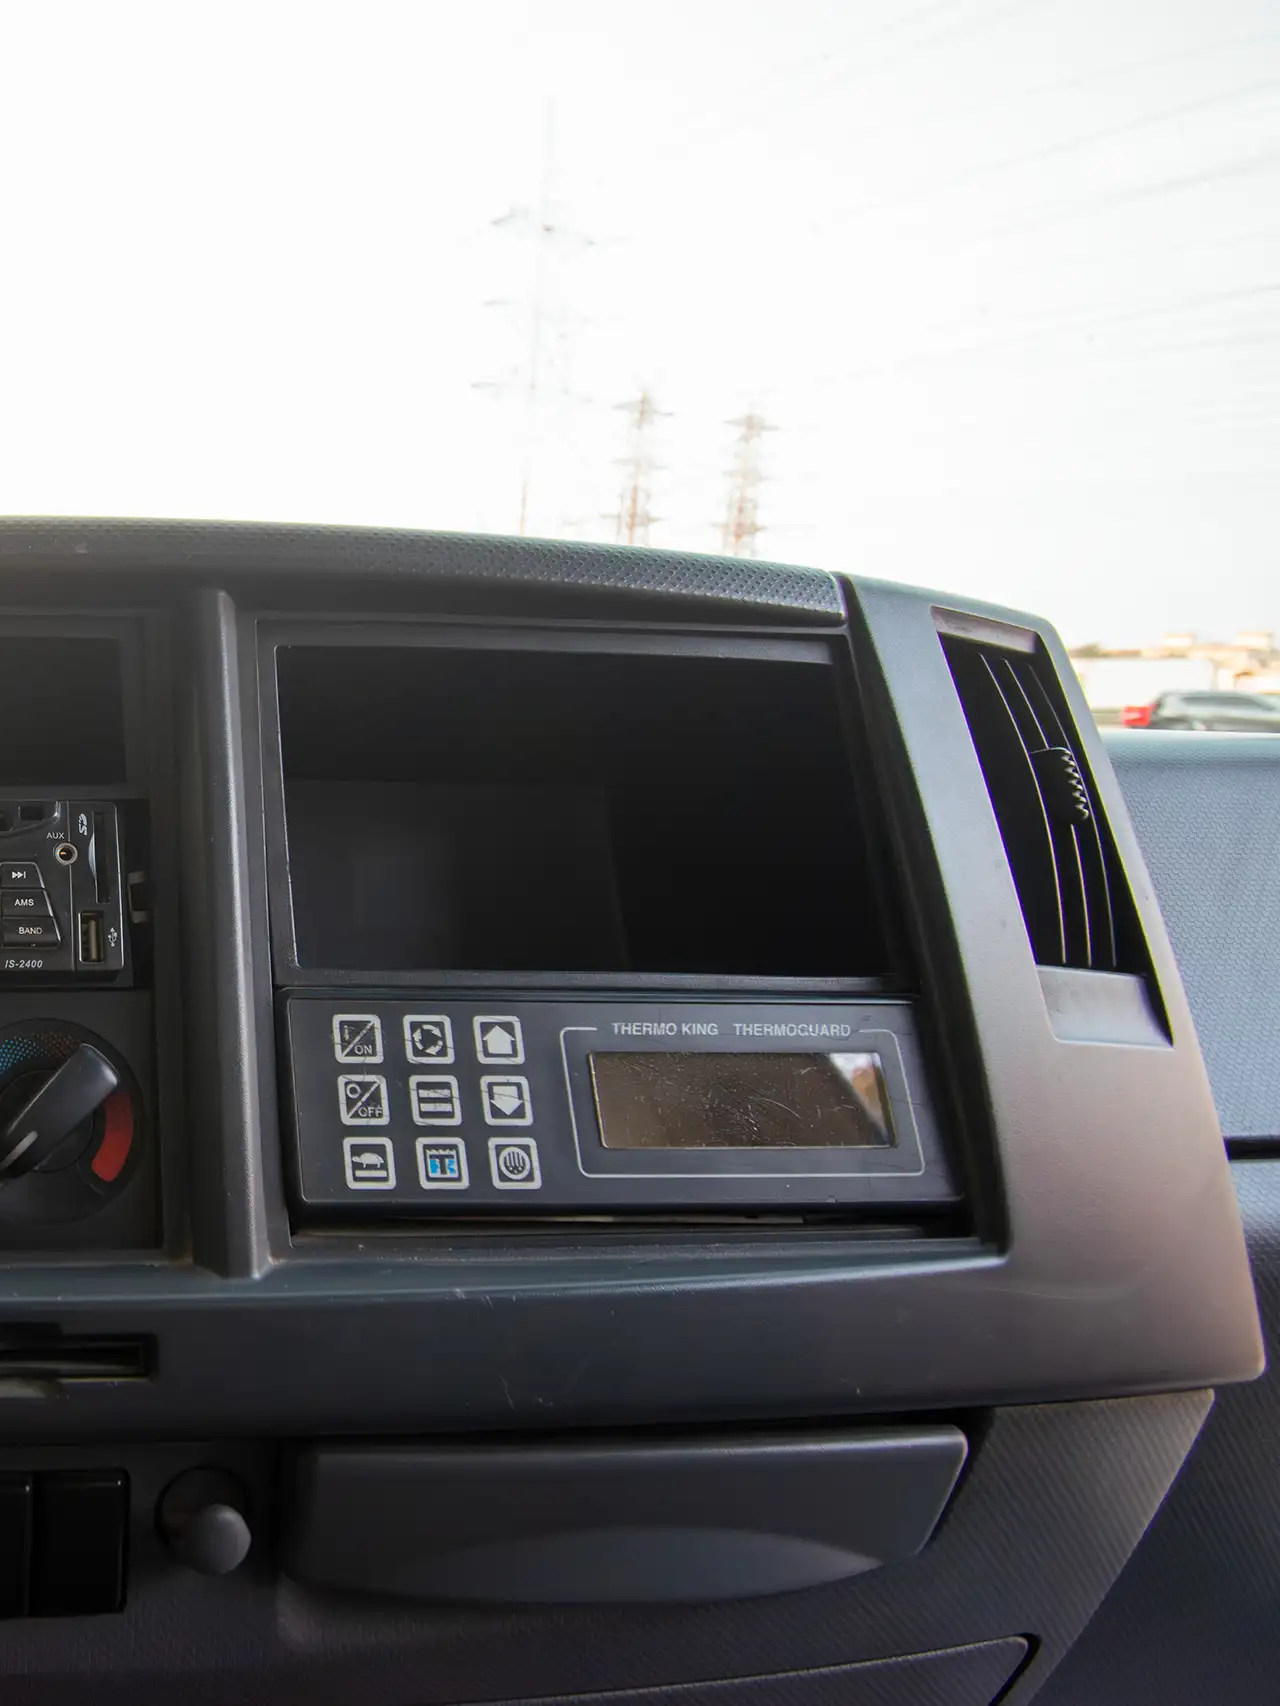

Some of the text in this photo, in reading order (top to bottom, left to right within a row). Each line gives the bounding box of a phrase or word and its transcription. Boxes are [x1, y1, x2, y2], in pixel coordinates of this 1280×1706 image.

[14, 898, 35, 907] AMS
[18, 927, 43, 935] BAND
[4, 959, 44, 969] IS-2400
[612, 1022, 851, 1037] THERMO KING THERMOGUARD
[354, 1044, 373, 1055] ON
[358, 1106, 383, 1117] OFF
